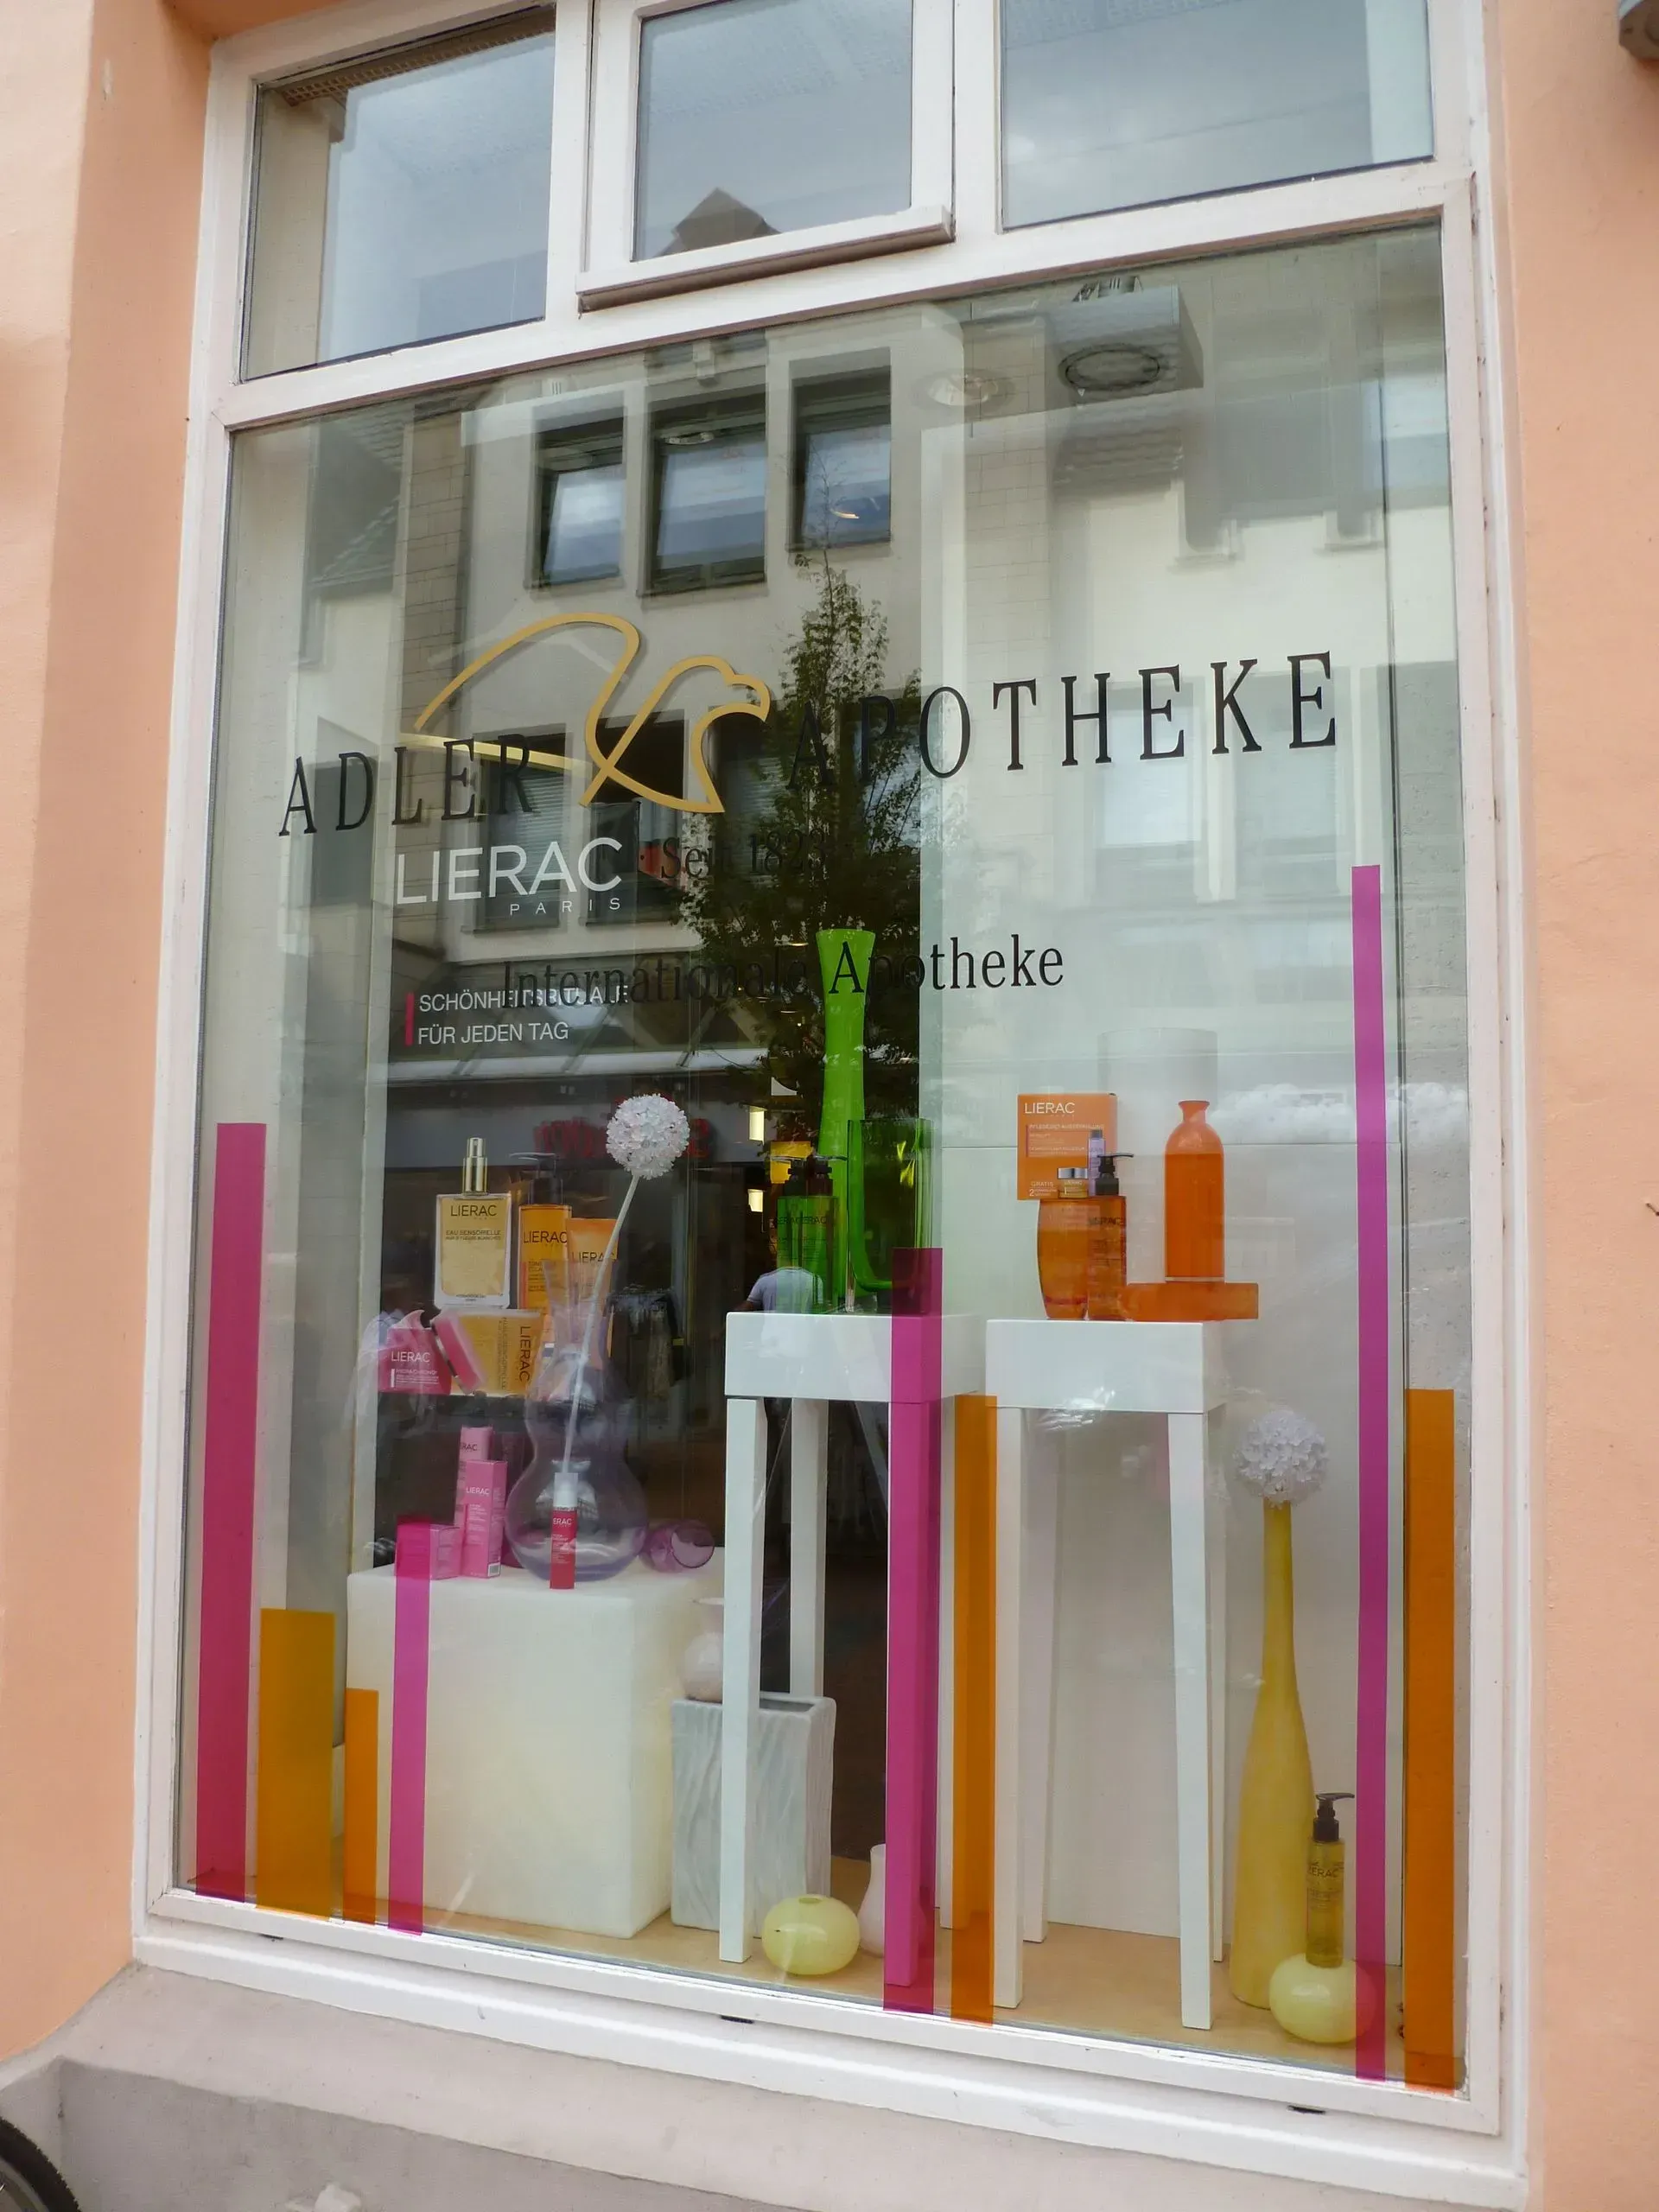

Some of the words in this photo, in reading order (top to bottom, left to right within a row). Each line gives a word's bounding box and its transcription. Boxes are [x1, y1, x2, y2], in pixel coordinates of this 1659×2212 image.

[279, 734, 533, 836] ADLER
[785, 650, 1336, 790] APOTHEKE
[660, 836, 734, 880] Seit
[396, 837, 622, 905] LIERAC
[510, 896, 621, 916] PARIS
[501, 947, 810, 1009] Internationale
[828, 934, 1065, 1005] Apotheke
[418, 1023, 456, 1046] FÜR
[461, 1022, 523, 1045] JEDEN
[528, 1020, 569, 1041] TAG
[1024, 1102, 1076, 1114] LIERAC
[450, 1205, 498, 1217] LIERAC
[523, 1230, 568, 1244] LIERAC
[391, 1351, 431, 1363] LIERAC
[518, 1325, 531, 1382] LIERAC
[466, 1486, 490, 1496] LIERAC
